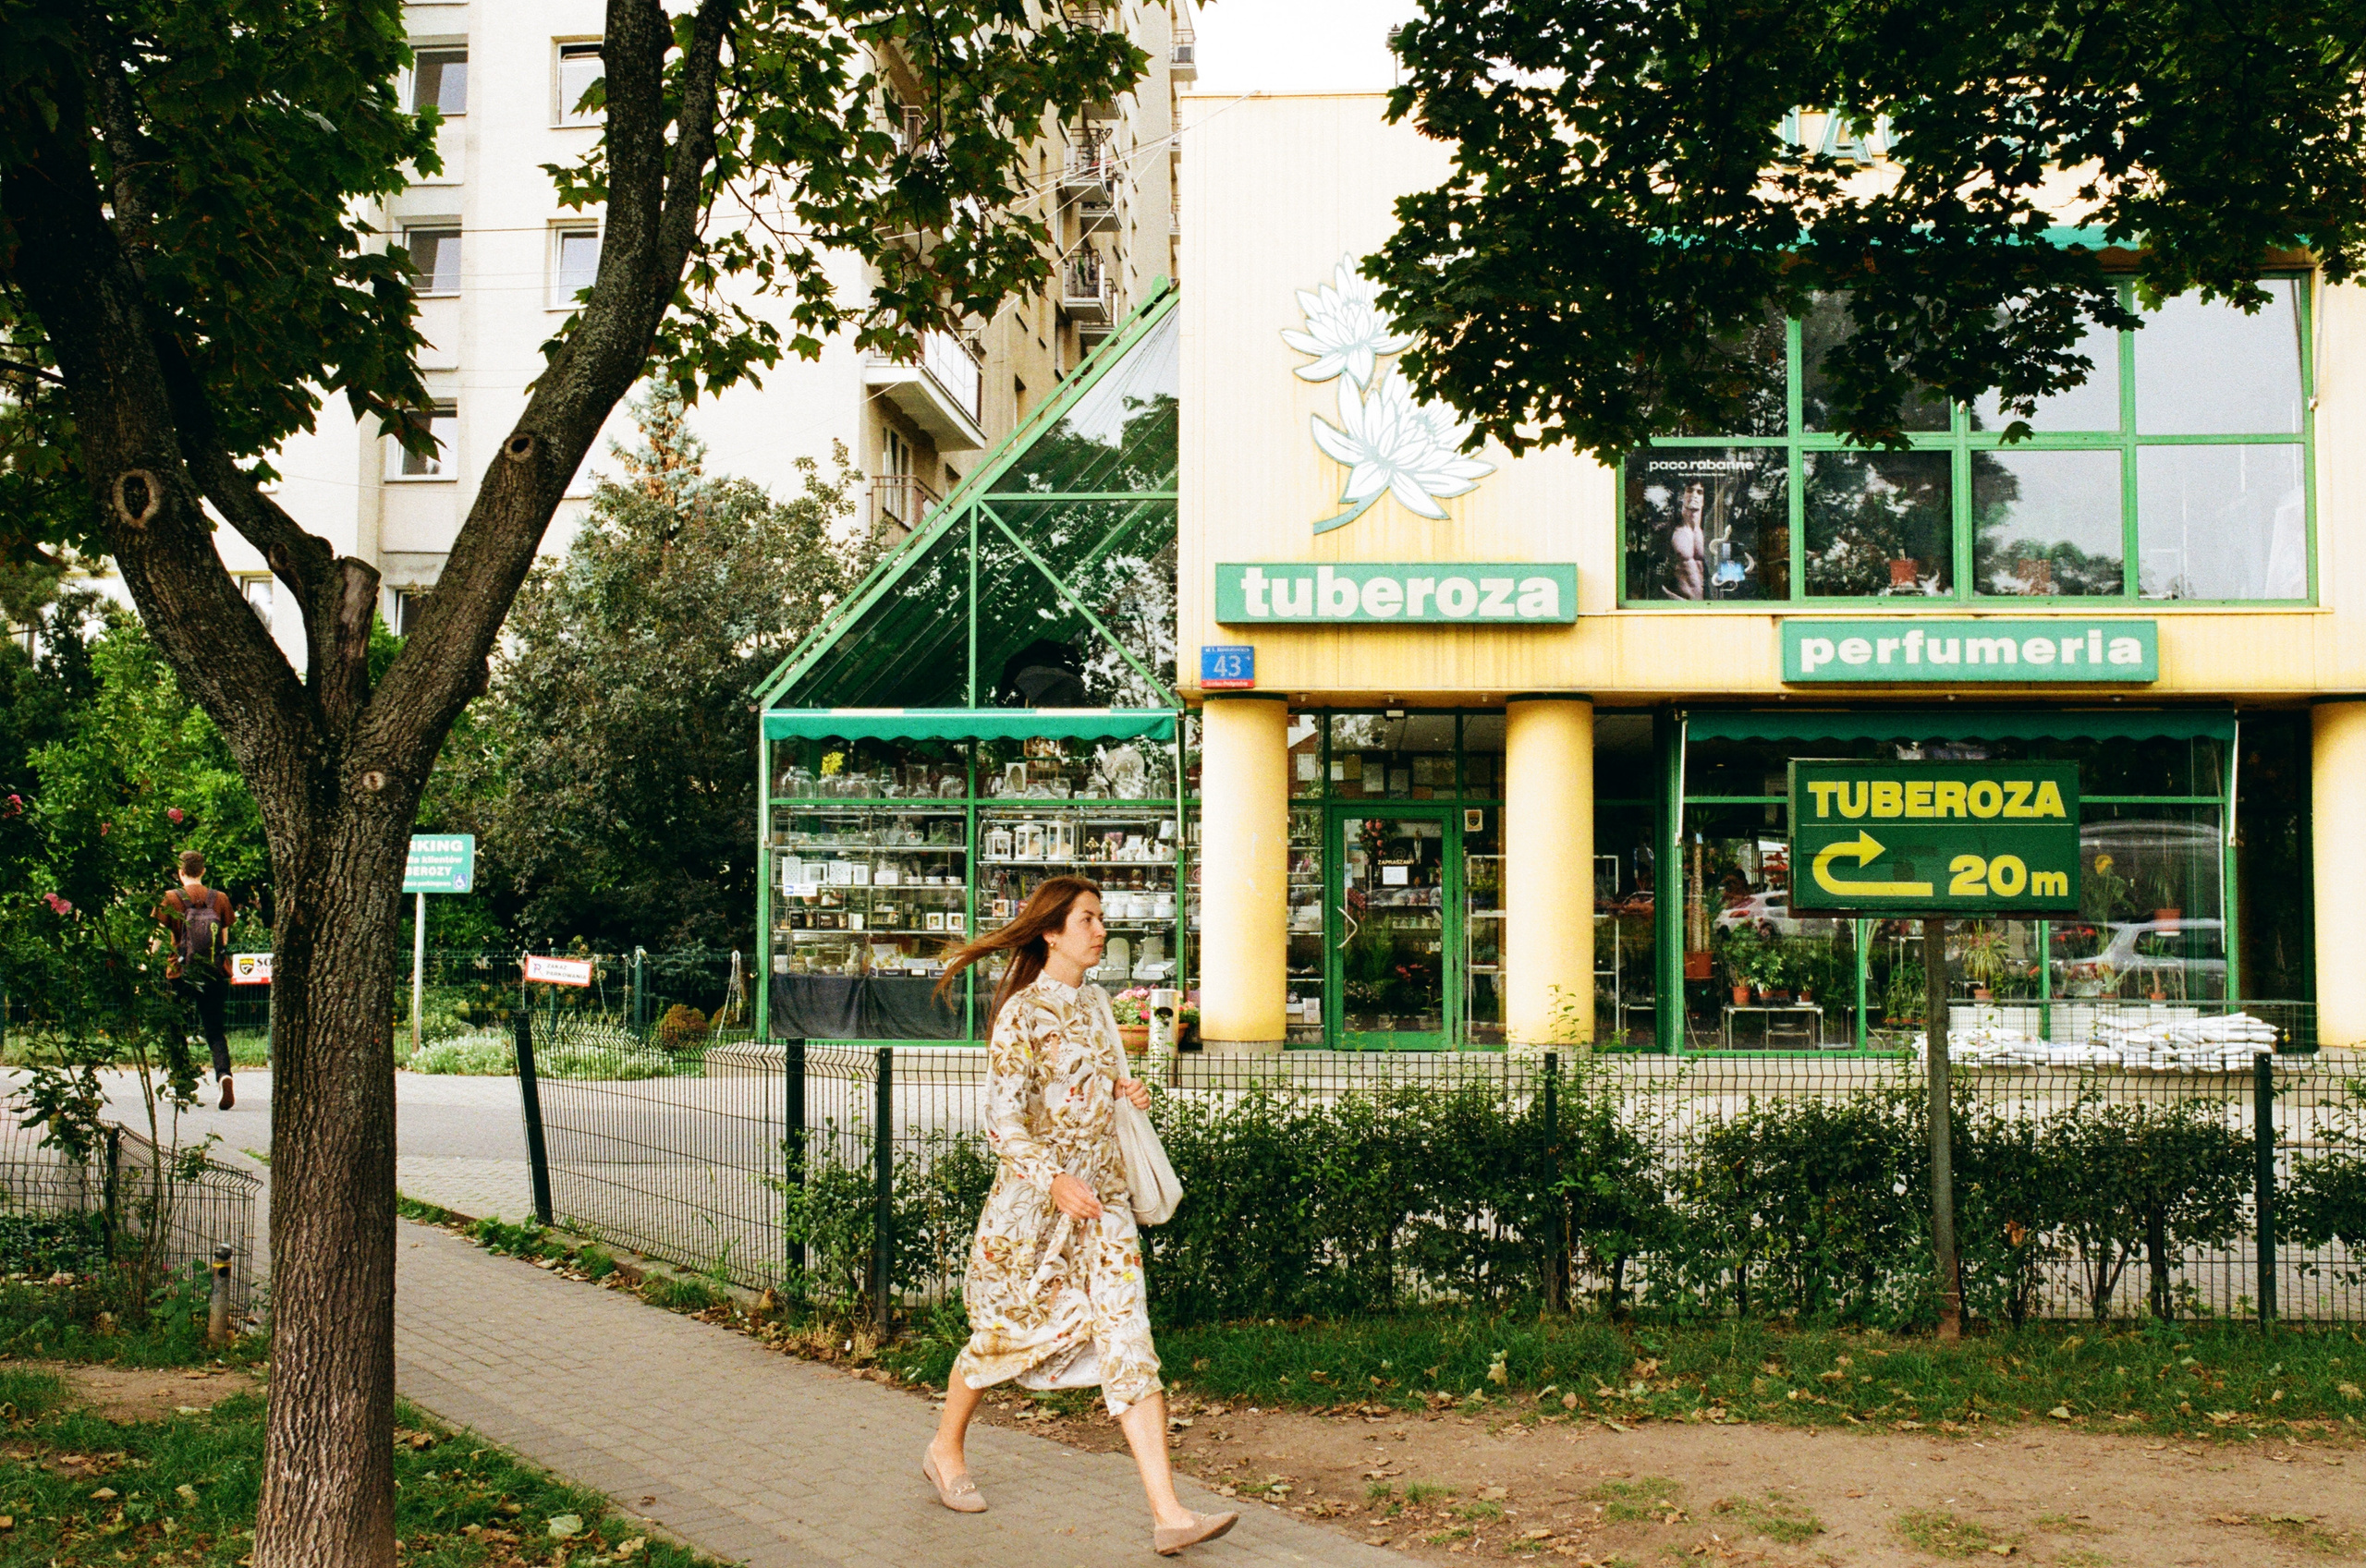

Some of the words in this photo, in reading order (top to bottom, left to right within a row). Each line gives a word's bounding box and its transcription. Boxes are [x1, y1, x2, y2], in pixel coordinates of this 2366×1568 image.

[1649, 461, 1688, 472] paco
[1689, 459, 1754, 470] rabanne
[1240, 565, 1561, 617] tuberoza
[1800, 628, 2142, 673] perfumeria
[1213, 655, 1241, 677] 43
[1808, 781, 2067, 819] TUBEROZA
[409, 840, 463, 852] RKING
[421, 856, 463, 864] klientów
[405, 866, 453, 876] BEROZY
[1948, 854, 2027, 897] 20
[2031, 871, 2068, 896] m
[546, 970, 587, 979] PARKOWANIA
